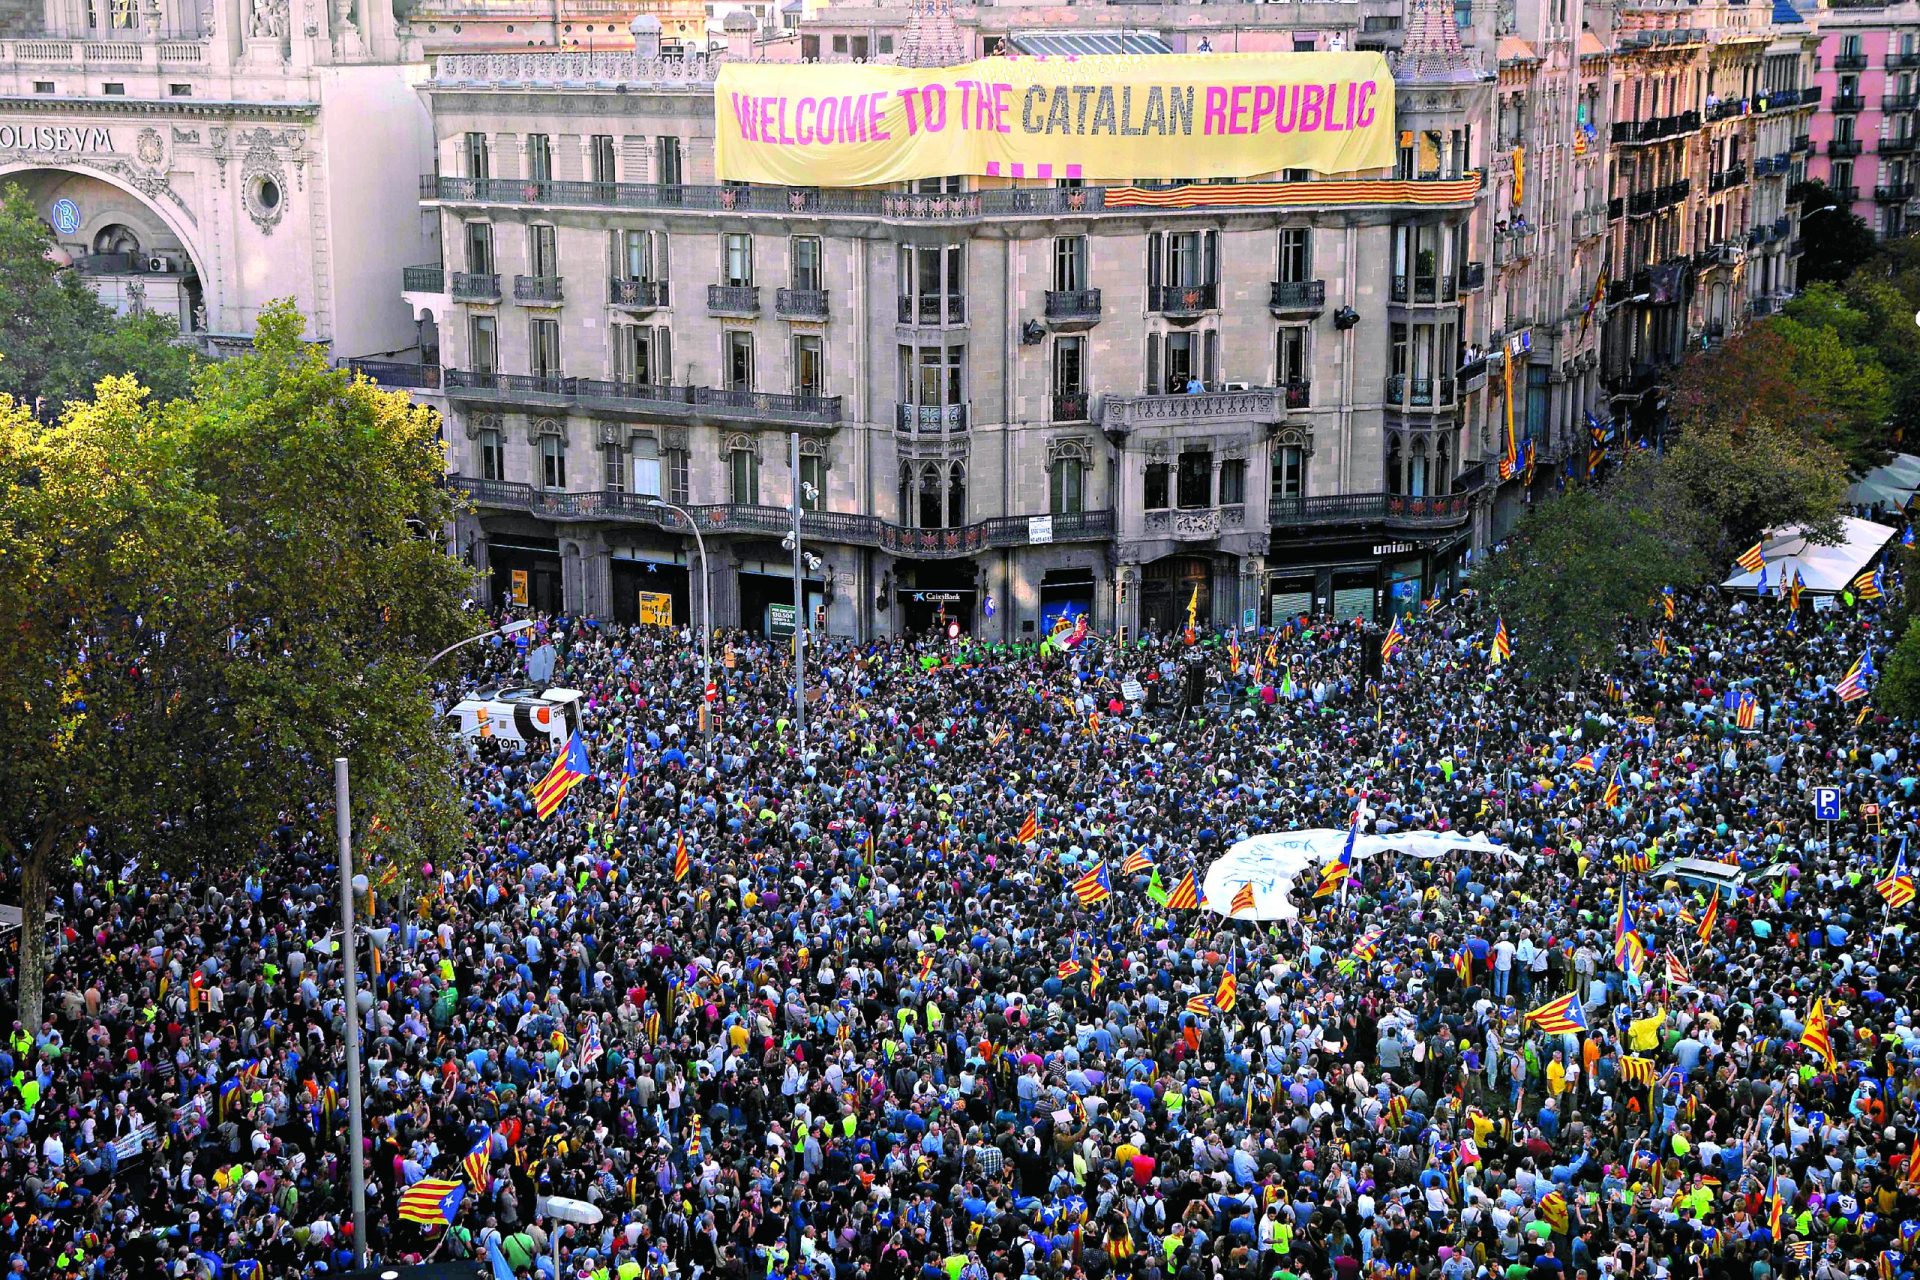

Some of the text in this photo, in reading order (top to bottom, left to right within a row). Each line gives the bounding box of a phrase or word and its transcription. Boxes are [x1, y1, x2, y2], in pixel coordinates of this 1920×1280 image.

[731, 80, 1377, 146] WELCOME TO THE CATALAN REPUBLIC
[926, 592, 960, 600] CaixaBank
[1820, 789, 1836, 808] P
